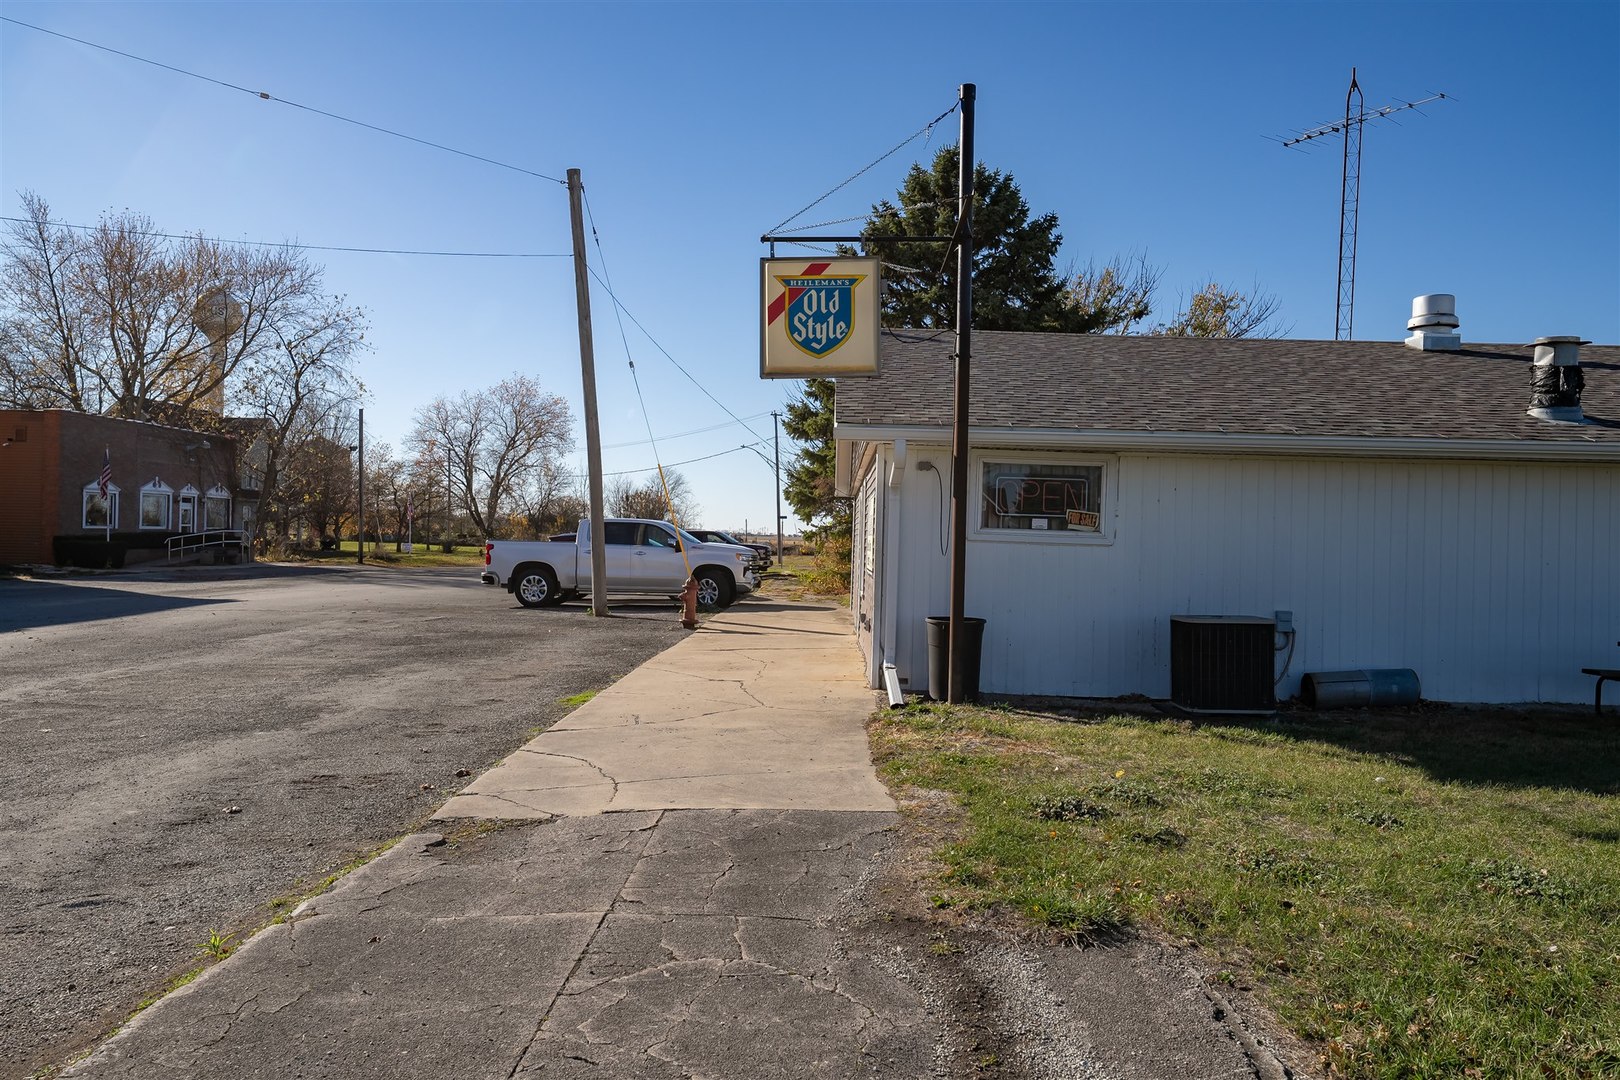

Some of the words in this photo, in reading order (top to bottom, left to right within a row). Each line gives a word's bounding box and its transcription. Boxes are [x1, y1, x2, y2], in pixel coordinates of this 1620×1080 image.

[803, 289, 839, 316] Old
[792, 311, 847, 350] Style
[999, 480, 1084, 513] OPEN
[1069, 511, 1080, 525] FOR
[1080, 513, 1096, 528] SALE
